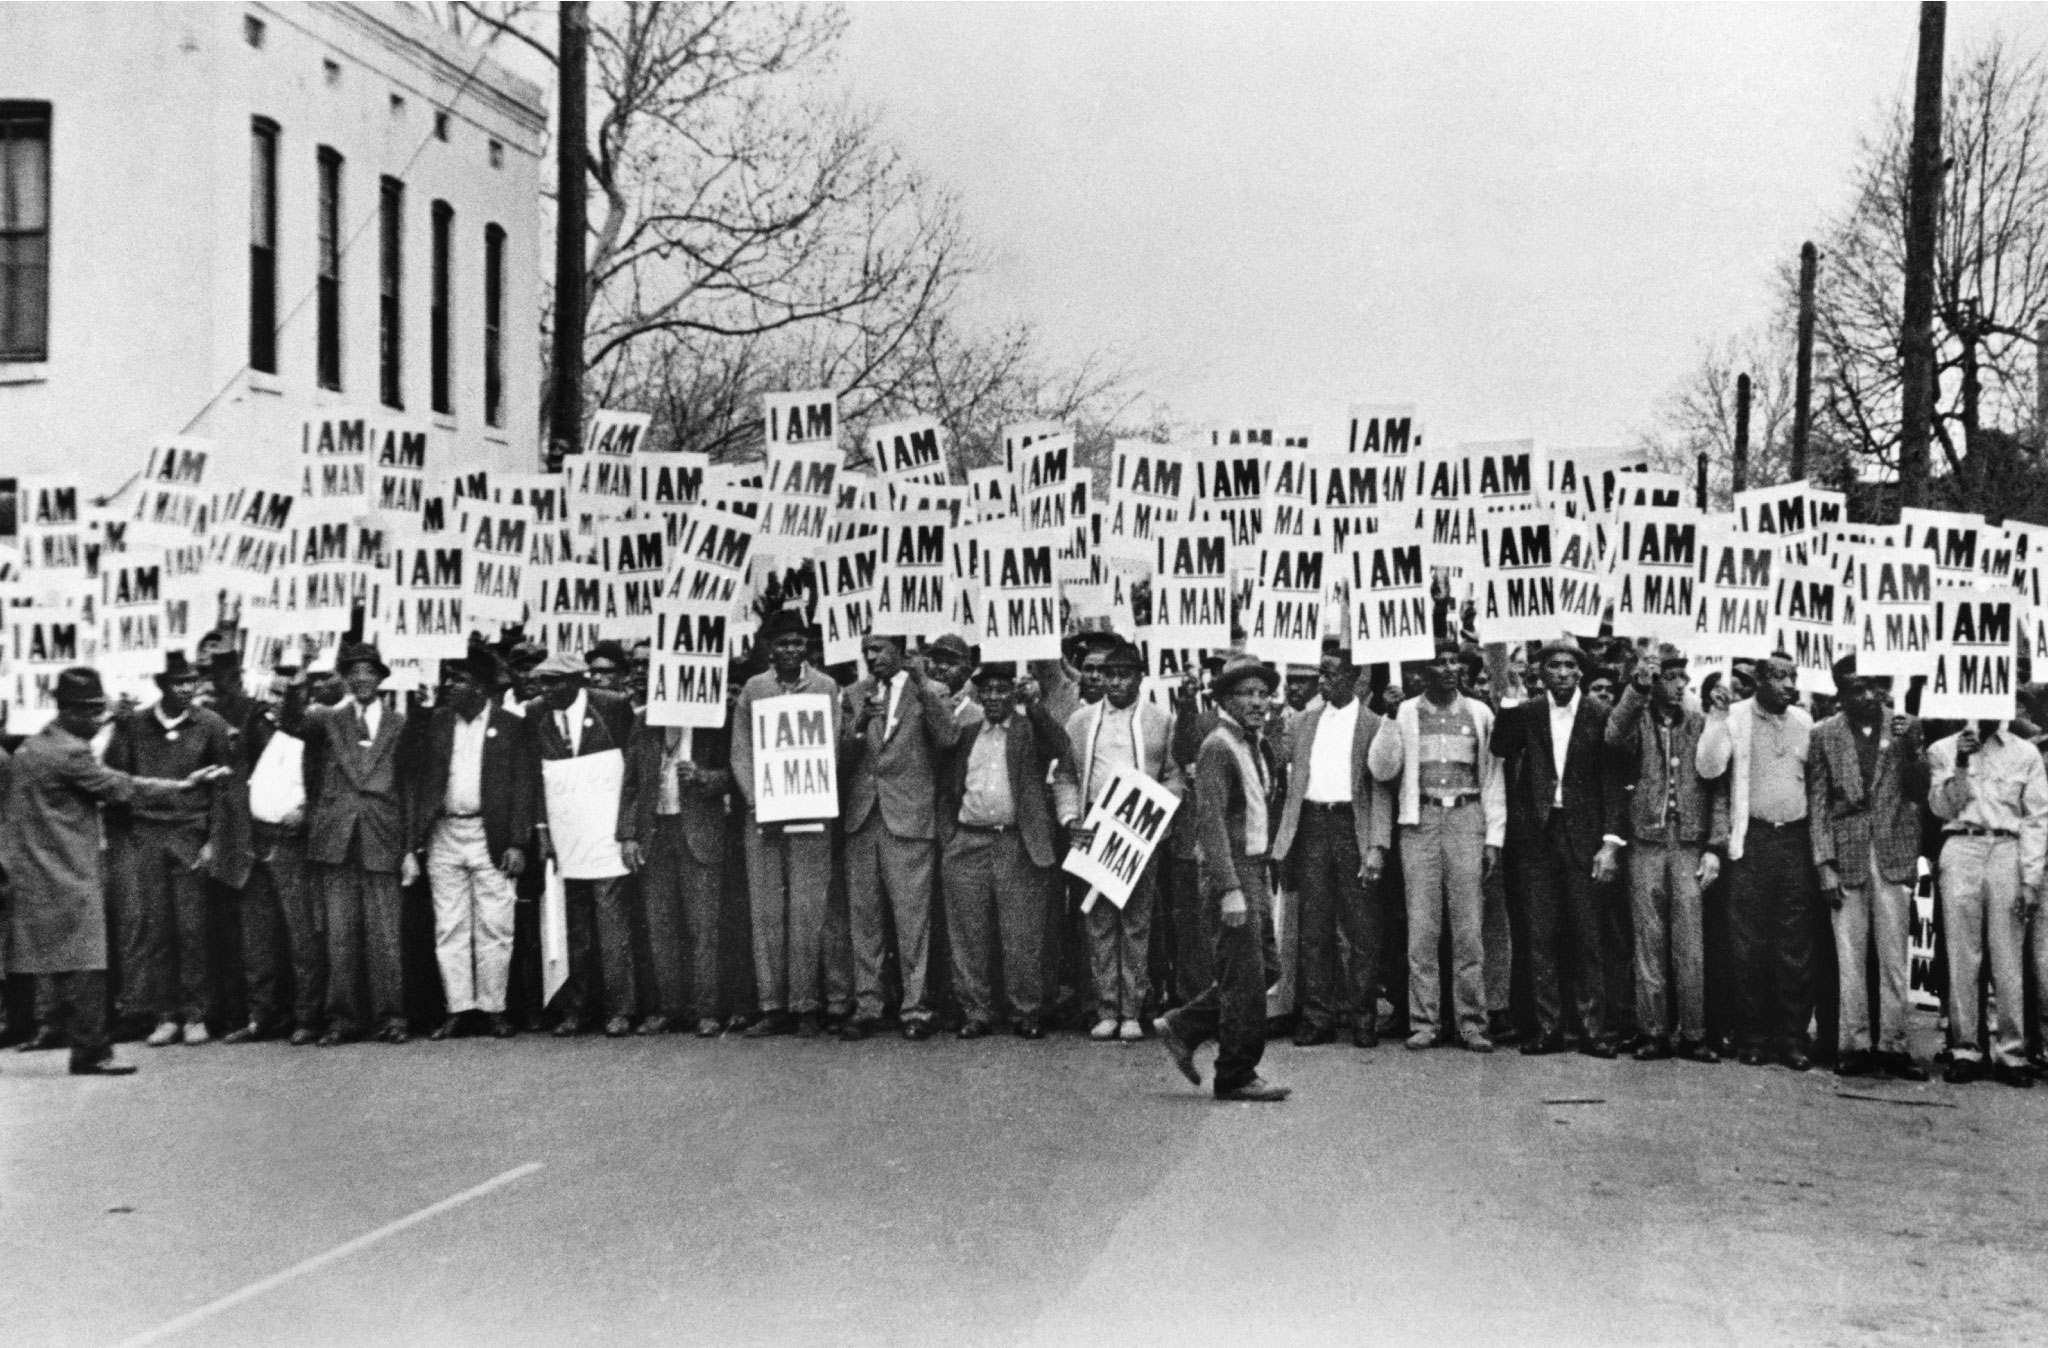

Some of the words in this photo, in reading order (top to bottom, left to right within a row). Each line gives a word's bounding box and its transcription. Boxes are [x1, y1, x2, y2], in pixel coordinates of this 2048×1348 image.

[302, 423, 309, 454] I
[318, 419, 364, 453] AM
[588, 422, 599, 451] I
[598, 424, 640, 455] AM
[771, 407, 778, 441] I
[787, 403, 832, 442] AM
[1350, 419, 1358, 453] I
[1363, 418, 1411, 453] AM
[145, 447, 158, 479] I
[159, 448, 206, 482] AM
[379, 430, 426, 468] AM
[877, 440, 887, 472] I
[894, 429, 939, 470] AM
[1007, 439, 1013, 472] I
[1030, 448, 1067, 488] AM
[302, 467, 312, 496] A
[323, 464, 363, 494] MAN
[598, 463, 631, 497] MAN
[641, 467, 647, 501] I
[656, 467, 703, 502] AM
[769, 460, 780, 491] I
[784, 461, 836, 496] AM
[1117, 454, 1126, 488] I
[1132, 457, 1182, 497] AM
[1198, 462, 1206, 498] I
[1214, 458, 1260, 499] AM
[1310, 469, 1317, 505] I
[1326, 468, 1377, 505] AM
[1417, 461, 1425, 495] I
[1463, 458, 1470, 495] I
[1480, 454, 1531, 495] AM
[38, 487, 76, 521] AM
[243, 491, 293, 530] AM
[382, 476, 422, 512] MAN
[1031, 494, 1065, 528] MAN
[760, 502, 773, 534] A
[780, 504, 827, 538] MAN
[1112, 501, 1123, 535] A
[1275, 505, 1303, 535] MA
[1759, 496, 1804, 534] AM
[290, 529, 298, 563] I
[304, 523, 348, 561] AM
[474, 516, 526, 553] AM
[603, 537, 610, 571] I
[618, 532, 663, 571] AM
[683, 520, 698, 553] I
[697, 525, 751, 568] AM
[882, 526, 889, 563] I
[896, 525, 944, 565] AM
[1482, 529, 1490, 567] I
[1499, 525, 1551, 568] AM
[1622, 521, 1630, 560] I
[1639, 523, 1695, 565] AM
[1924, 527, 1977, 568] AM
[396, 550, 403, 585] I
[411, 548, 462, 586] AM
[984, 550, 991, 587] I
[1001, 546, 1051, 586] AM
[1158, 537, 1164, 574] I
[1174, 536, 1225, 575] AM
[1273, 551, 1323, 590] AM
[1353, 551, 1361, 589] I
[1371, 545, 1422, 588] AM
[1699, 545, 1708, 583] I
[1715, 547, 1772, 586] AM
[117, 566, 159, 602] AM
[476, 562, 520, 598] MAN
[540, 580, 547, 612] I
[554, 578, 600, 614] AM
[668, 566, 685, 598] A
[689, 570, 735, 601] MAN
[820, 561, 829, 596] I
[879, 576, 890, 612] A
[901, 576, 943, 612] MAN
[1487, 580, 1498, 618] A
[1507, 577, 1554, 616] MAN
[1560, 578, 1601, 615] MAN
[1621, 574, 1632, 612] A
[1644, 575, 1693, 615] MAN
[1860, 563, 1867, 600] I
[1878, 563, 1930, 601] AM
[2032, 568, 2040, 606] I
[396, 600, 406, 634] A
[418, 598, 461, 633] MAN
[606, 583, 617, 617] A
[987, 600, 998, 637] A
[1008, 598, 1053, 636] MAN
[1158, 588, 1169, 625] A
[1180, 588, 1225, 624] MAN
[1359, 603, 1369, 639] A
[1379, 598, 1426, 637] MAN
[1696, 597, 1707, 632] A
[1719, 598, 1768, 635] MAN
[1775, 578, 1785, 615] I
[1789, 580, 1834, 622] AM
[658, 613, 665, 650] I
[673, 614, 726, 654] AM
[829, 607, 839, 641] A
[1254, 601, 1264, 637] A
[1274, 601, 1319, 639] MAN
[1864, 614, 1875, 650] A
[1936, 602, 1943, 641] I
[1953, 602, 2011, 644] AM
[14, 624, 20, 659] I
[31, 624, 76, 660] AM
[1796, 630, 1835, 672] MAN
[655, 664, 666, 701] A
[678, 665, 722, 703] MAN
[1934, 655, 1947, 693] A
[1959, 655, 2009, 694] MAN
[759, 715, 765, 749] I
[776, 710, 826, 747] AM
[764, 763, 773, 796] A
[784, 759, 829, 793] MAN
[1101, 777, 1121, 809] I
[1115, 788, 1166, 841] AM
[1098, 831, 1143, 884] MAN
